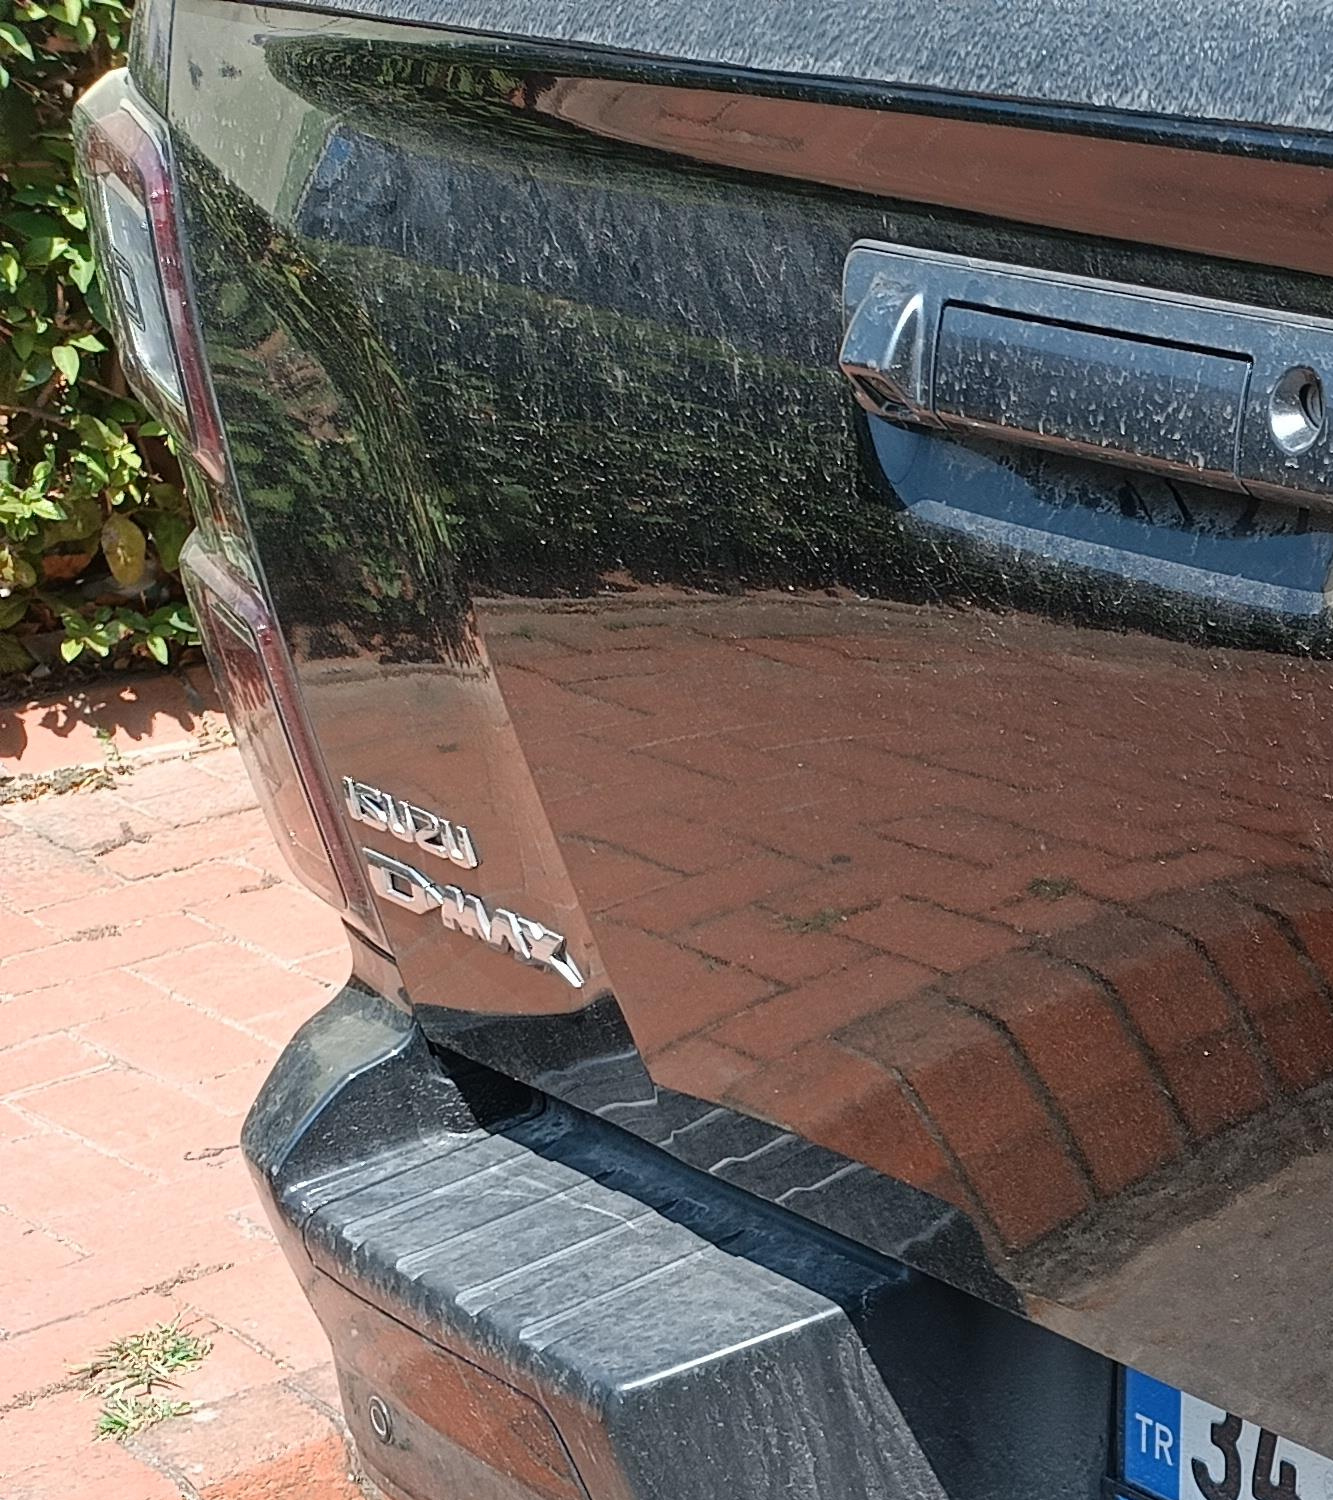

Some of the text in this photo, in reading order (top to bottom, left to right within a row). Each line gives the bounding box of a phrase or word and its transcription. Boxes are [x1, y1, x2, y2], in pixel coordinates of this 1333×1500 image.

[342, 776, 482, 870] ISUZU
[362, 847, 585, 989] D-MAX
[1135, 1412, 1174, 1467] TR
